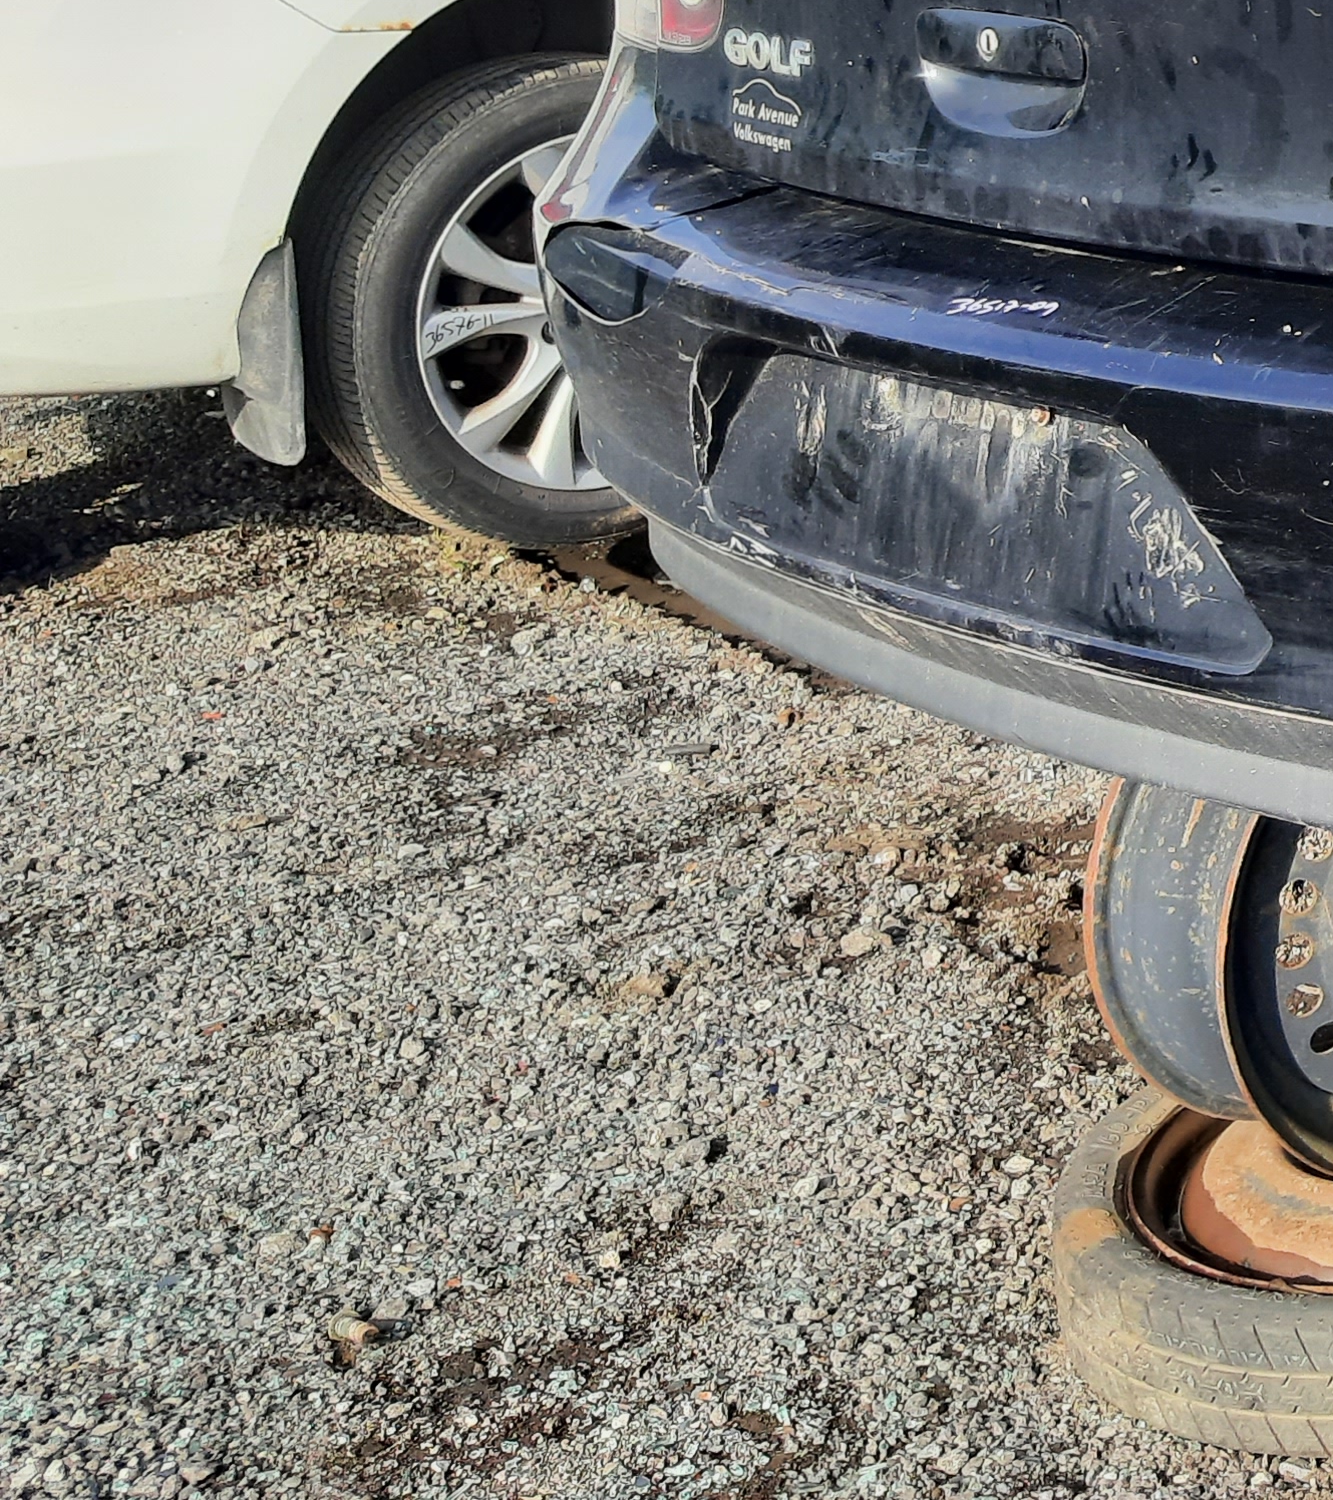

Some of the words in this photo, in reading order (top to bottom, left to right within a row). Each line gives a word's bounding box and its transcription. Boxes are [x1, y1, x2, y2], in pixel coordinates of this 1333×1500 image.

[724, 27, 812, 77] GOLF
[732, 97, 755, 119] Park
[757, 102, 799, 128] Avenue
[733, 121, 792, 153] Volkswagen
[425, 313, 493, 354] 36576-11
